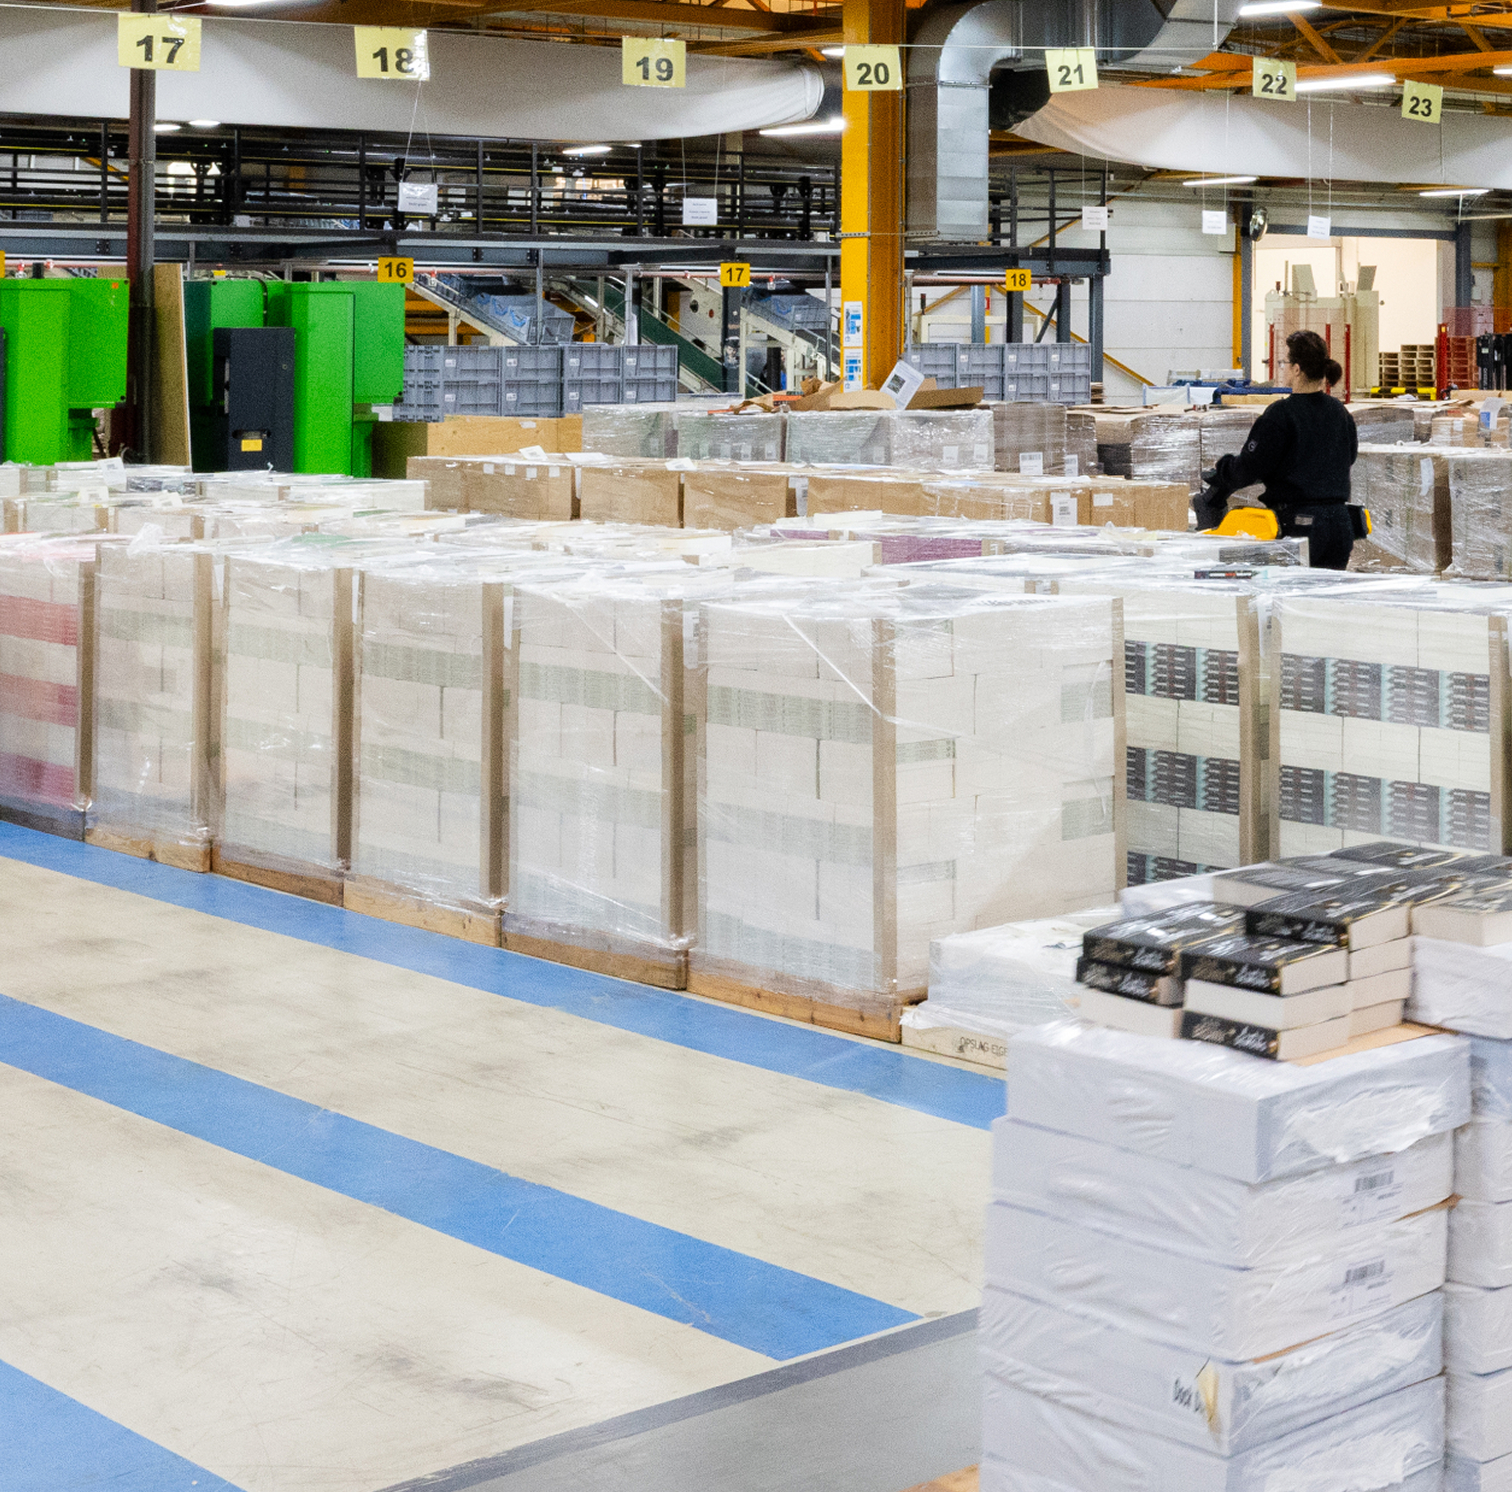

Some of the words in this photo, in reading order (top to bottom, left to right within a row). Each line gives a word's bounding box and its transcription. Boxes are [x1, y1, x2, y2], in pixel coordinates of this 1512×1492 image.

[136, 35, 184, 63] 17
[372, 47, 414, 72] 18
[636, 57, 673, 81] 19
[857, 62, 889, 85] 20
[1058, 64, 1085, 85] 21
[1261, 74, 1287, 94] 22
[1409, 96, 1432, 117] 23
[385, 262, 407, 278] 16
[726, 268, 744, 281] 17
[1011, 274, 1026, 286] 18
[960, 1036, 990, 1052] OPSLAG
